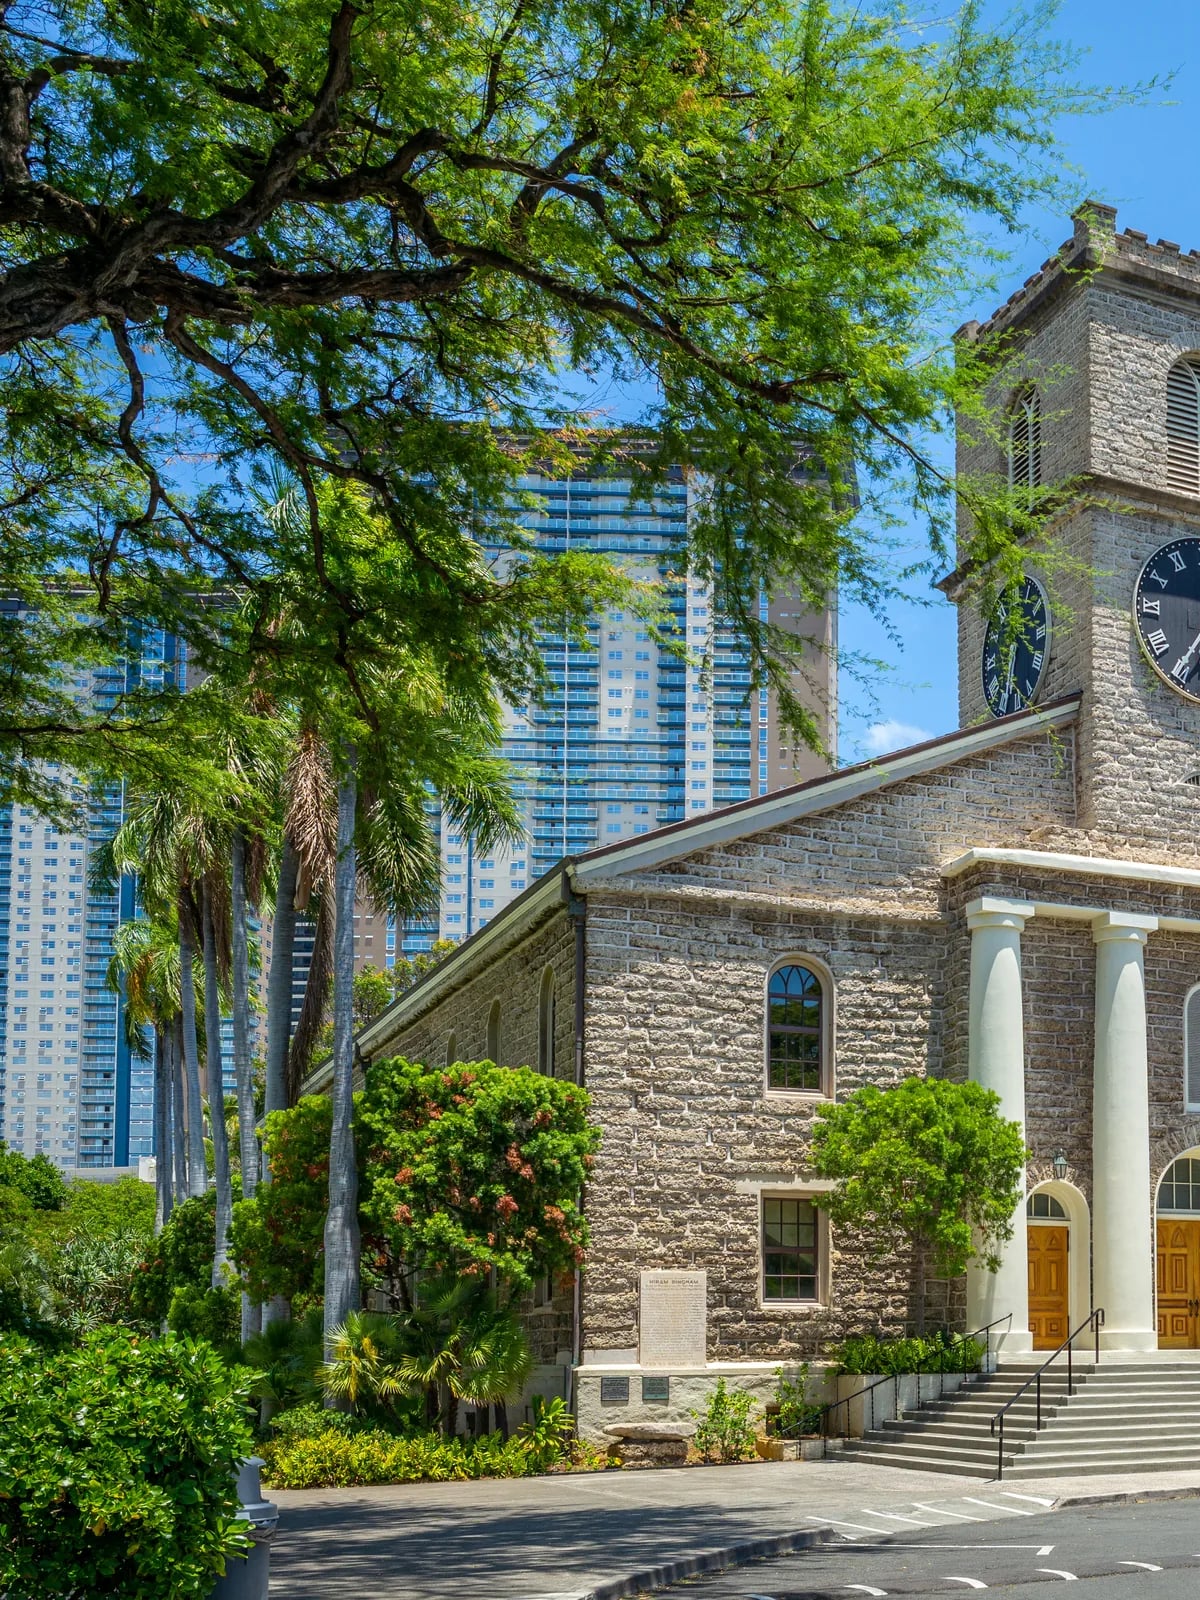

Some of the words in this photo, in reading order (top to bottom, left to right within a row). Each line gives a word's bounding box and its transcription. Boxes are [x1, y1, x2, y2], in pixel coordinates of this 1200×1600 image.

[1168, 550, 1186, 572] XI
[1150, 569, 1168, 589] X
[1032, 598, 1042, 616] II
[1143, 597, 1160, 616] IX
[1036, 624, 1045, 640] III
[1147, 628, 1170, 656] VIII
[987, 653, 996, 671] IX
[1032, 651, 1043, 671] IIII
[1171, 658, 1190, 684] VII
[1026, 680, 1033, 696] V
